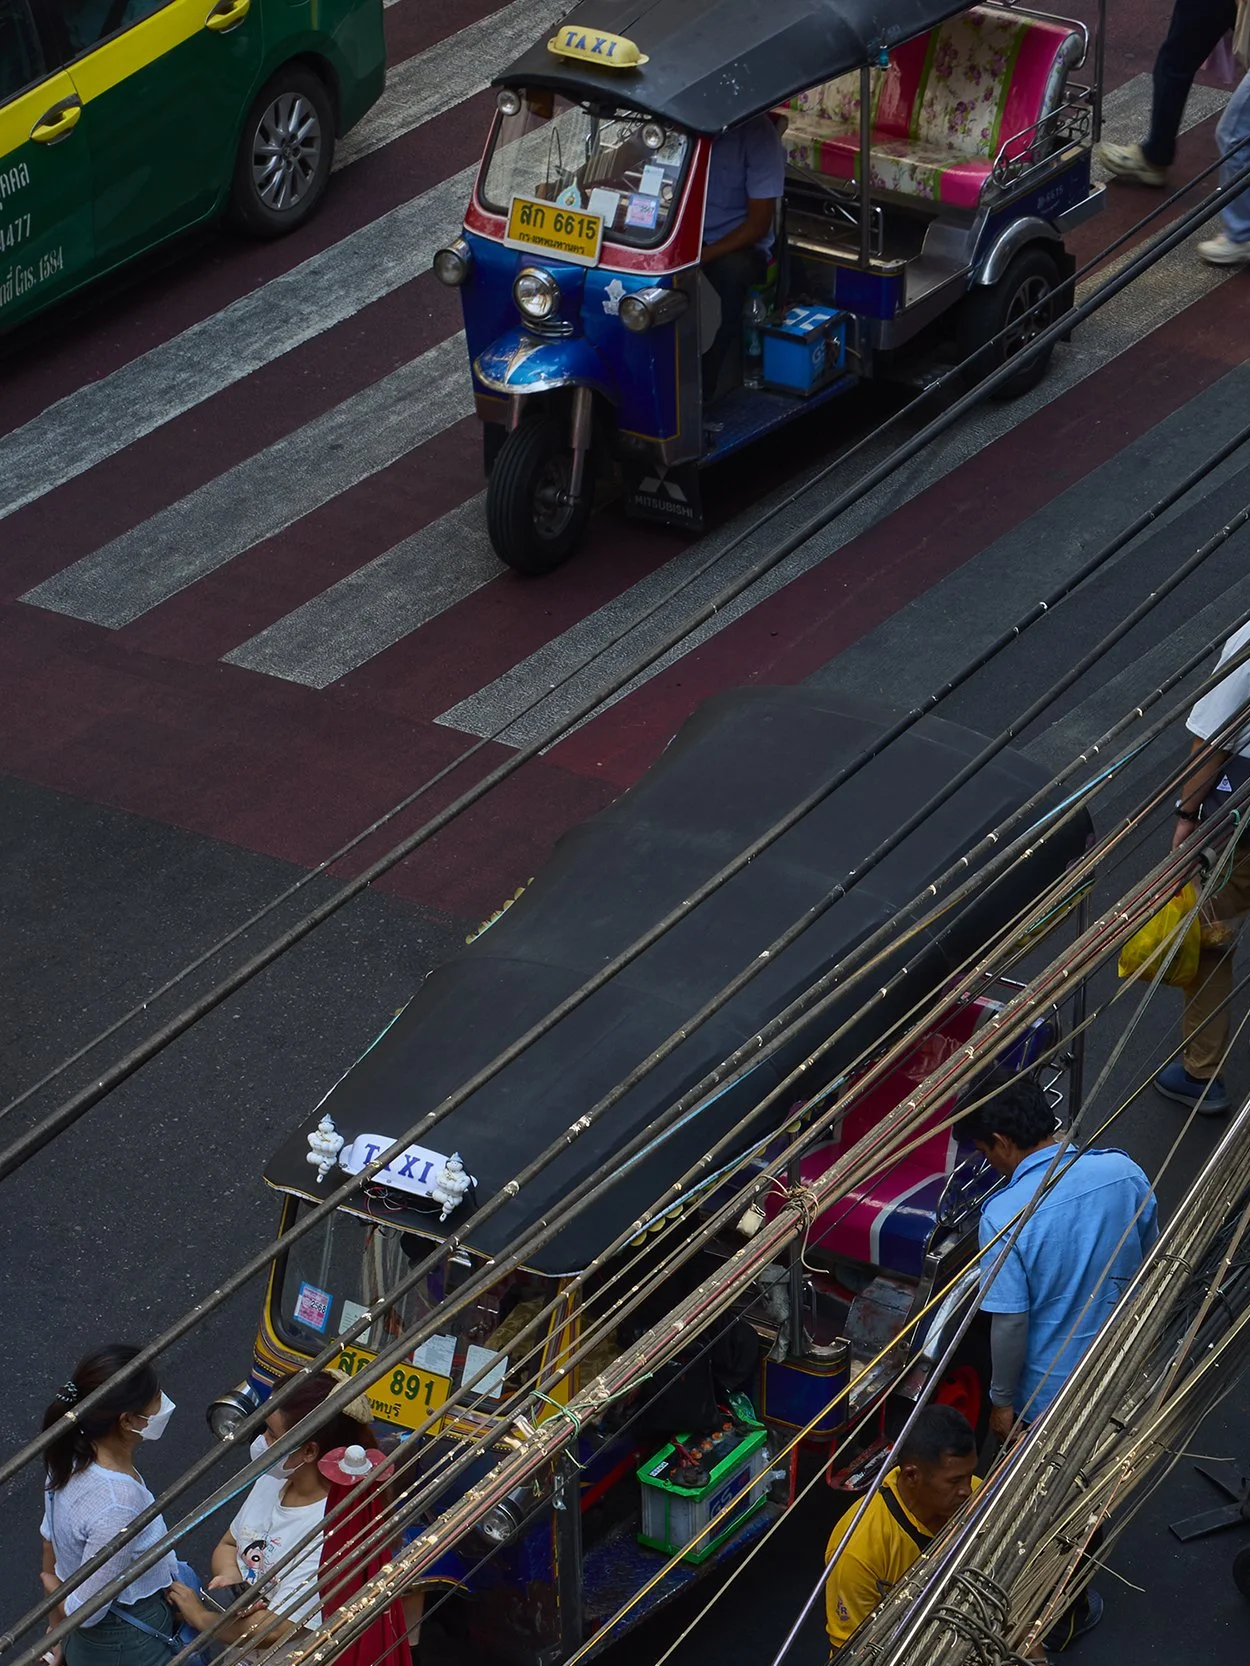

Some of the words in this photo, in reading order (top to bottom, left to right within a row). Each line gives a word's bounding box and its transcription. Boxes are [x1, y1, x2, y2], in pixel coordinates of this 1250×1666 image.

[564, 30, 618, 58] TAXI
[519, 203, 546, 229] สก
[553, 212, 597, 241] 6615
[39, 245, 64, 282] 1584
[634, 494, 694, 519] MITSUBISHI
[390, 1370, 435, 1406] 891
